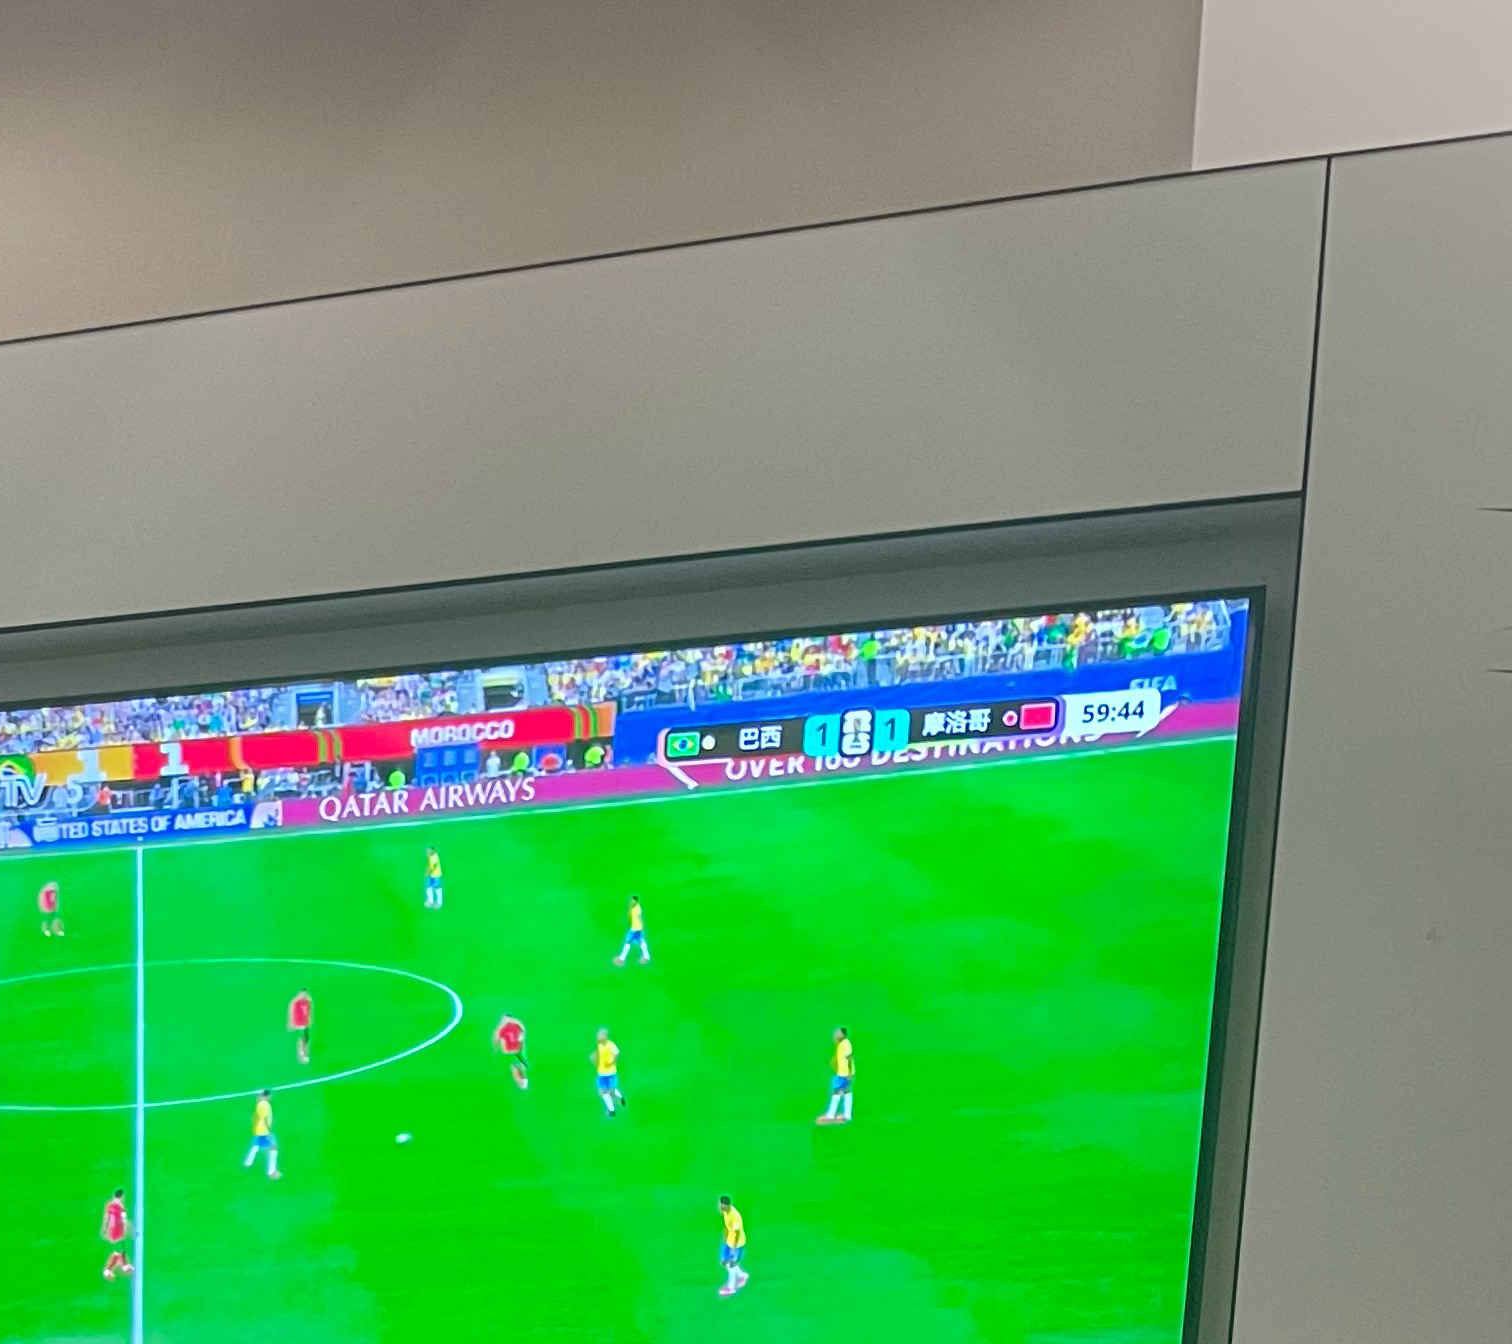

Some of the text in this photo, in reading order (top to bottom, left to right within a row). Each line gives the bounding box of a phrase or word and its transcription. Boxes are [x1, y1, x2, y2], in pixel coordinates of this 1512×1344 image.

[922, 707, 992, 736] 摩洛哥
[1082, 700, 1145, 724] 59:44
[410, 719, 515, 747] MOROCCO
[739, 725, 783, 751] 巴西
[724, 755, 805, 780] OVER
[871, 735, 1104, 766] DESTINA
[318, 777, 536, 821] QATAR AIRWAYS
[33, 809, 248, 843] TED STATES OF AMERICA
